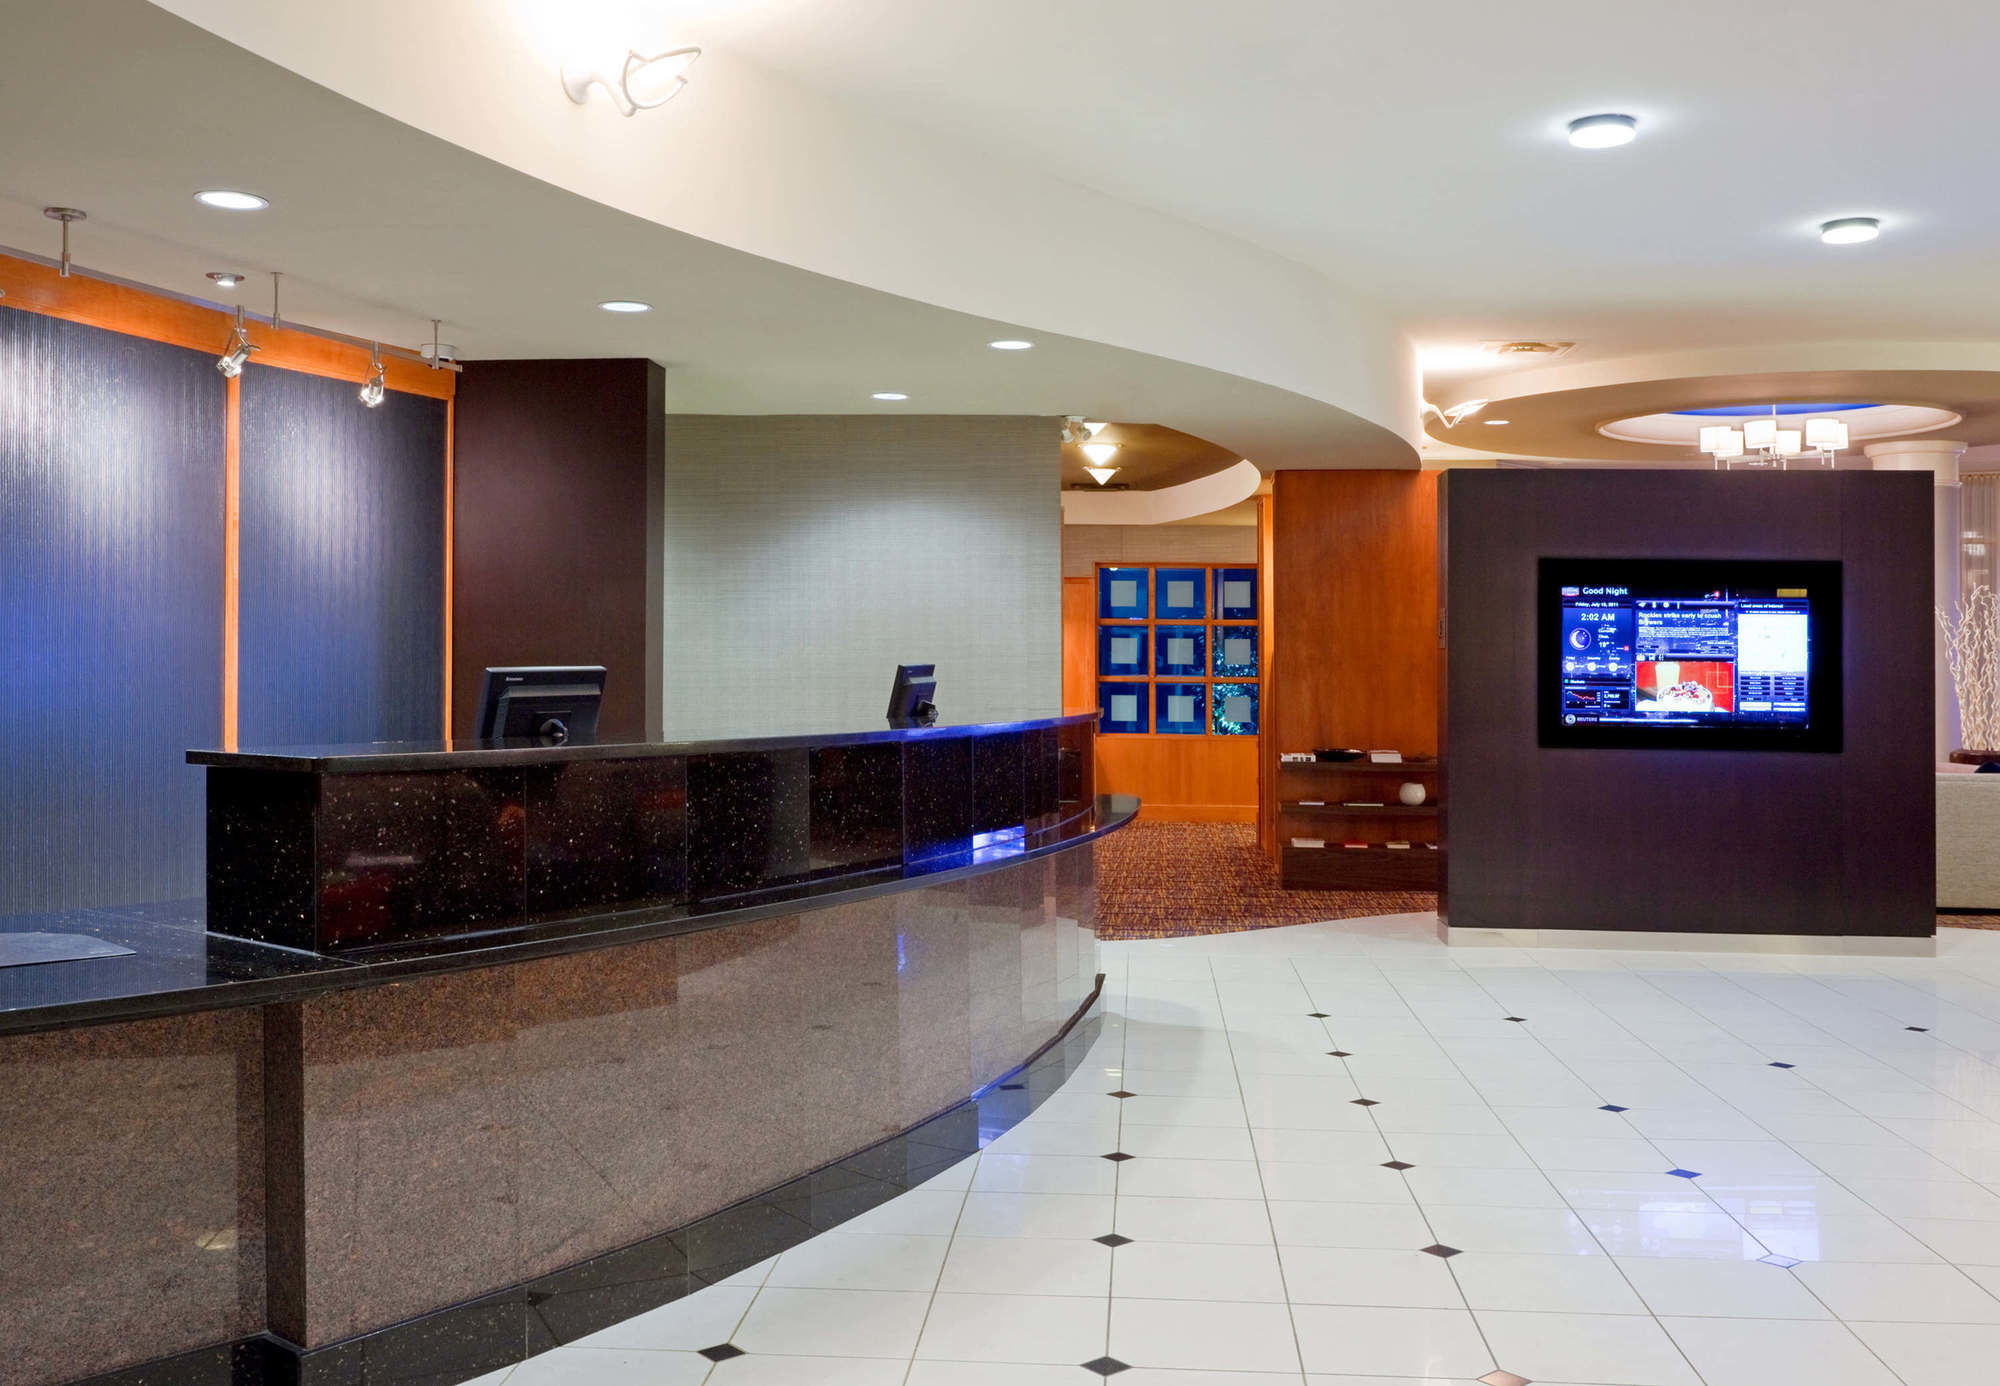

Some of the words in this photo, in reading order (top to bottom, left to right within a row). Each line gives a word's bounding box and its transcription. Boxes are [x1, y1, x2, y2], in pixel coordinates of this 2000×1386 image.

[1582, 587, 1604, 595] Good
[1605, 586, 1628, 596] Night
[1581, 613, 1599, 621] 2:02
[1601, 613, 1615, 621] AM
[1681, 612, 1695, 620] early
